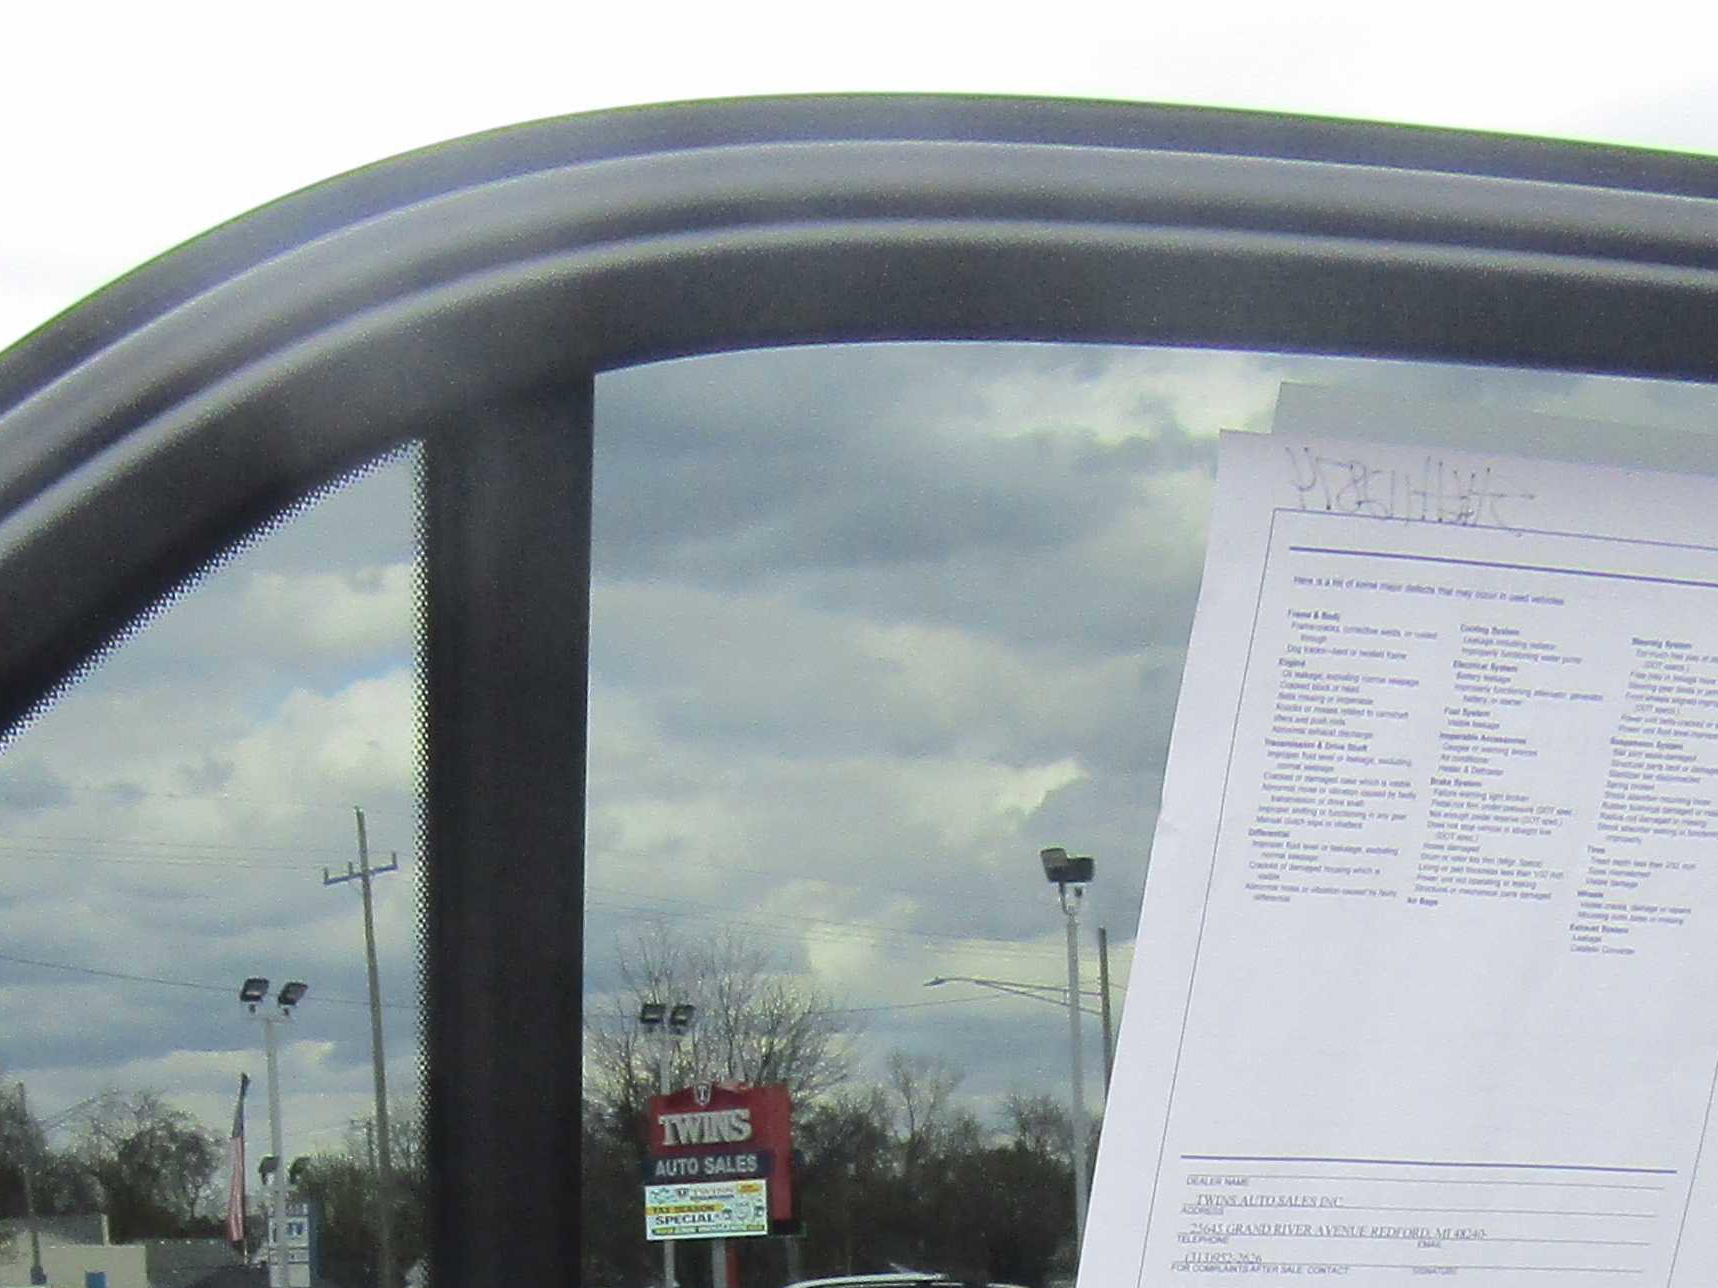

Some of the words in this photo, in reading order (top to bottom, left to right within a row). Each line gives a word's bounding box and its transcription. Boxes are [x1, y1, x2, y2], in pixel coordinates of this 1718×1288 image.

[658, 1108, 753, 1146] TWINS
[655, 1157, 699, 1177] AUTO
[704, 1154, 758, 1174] SALES
[1195, 1193, 1238, 1207] TWINS
[1238, 1194, 1276, 1208] AUTO
[1276, 1195, 1318, 1209] SALES
[655, 1214, 715, 1226] SPECIAL
